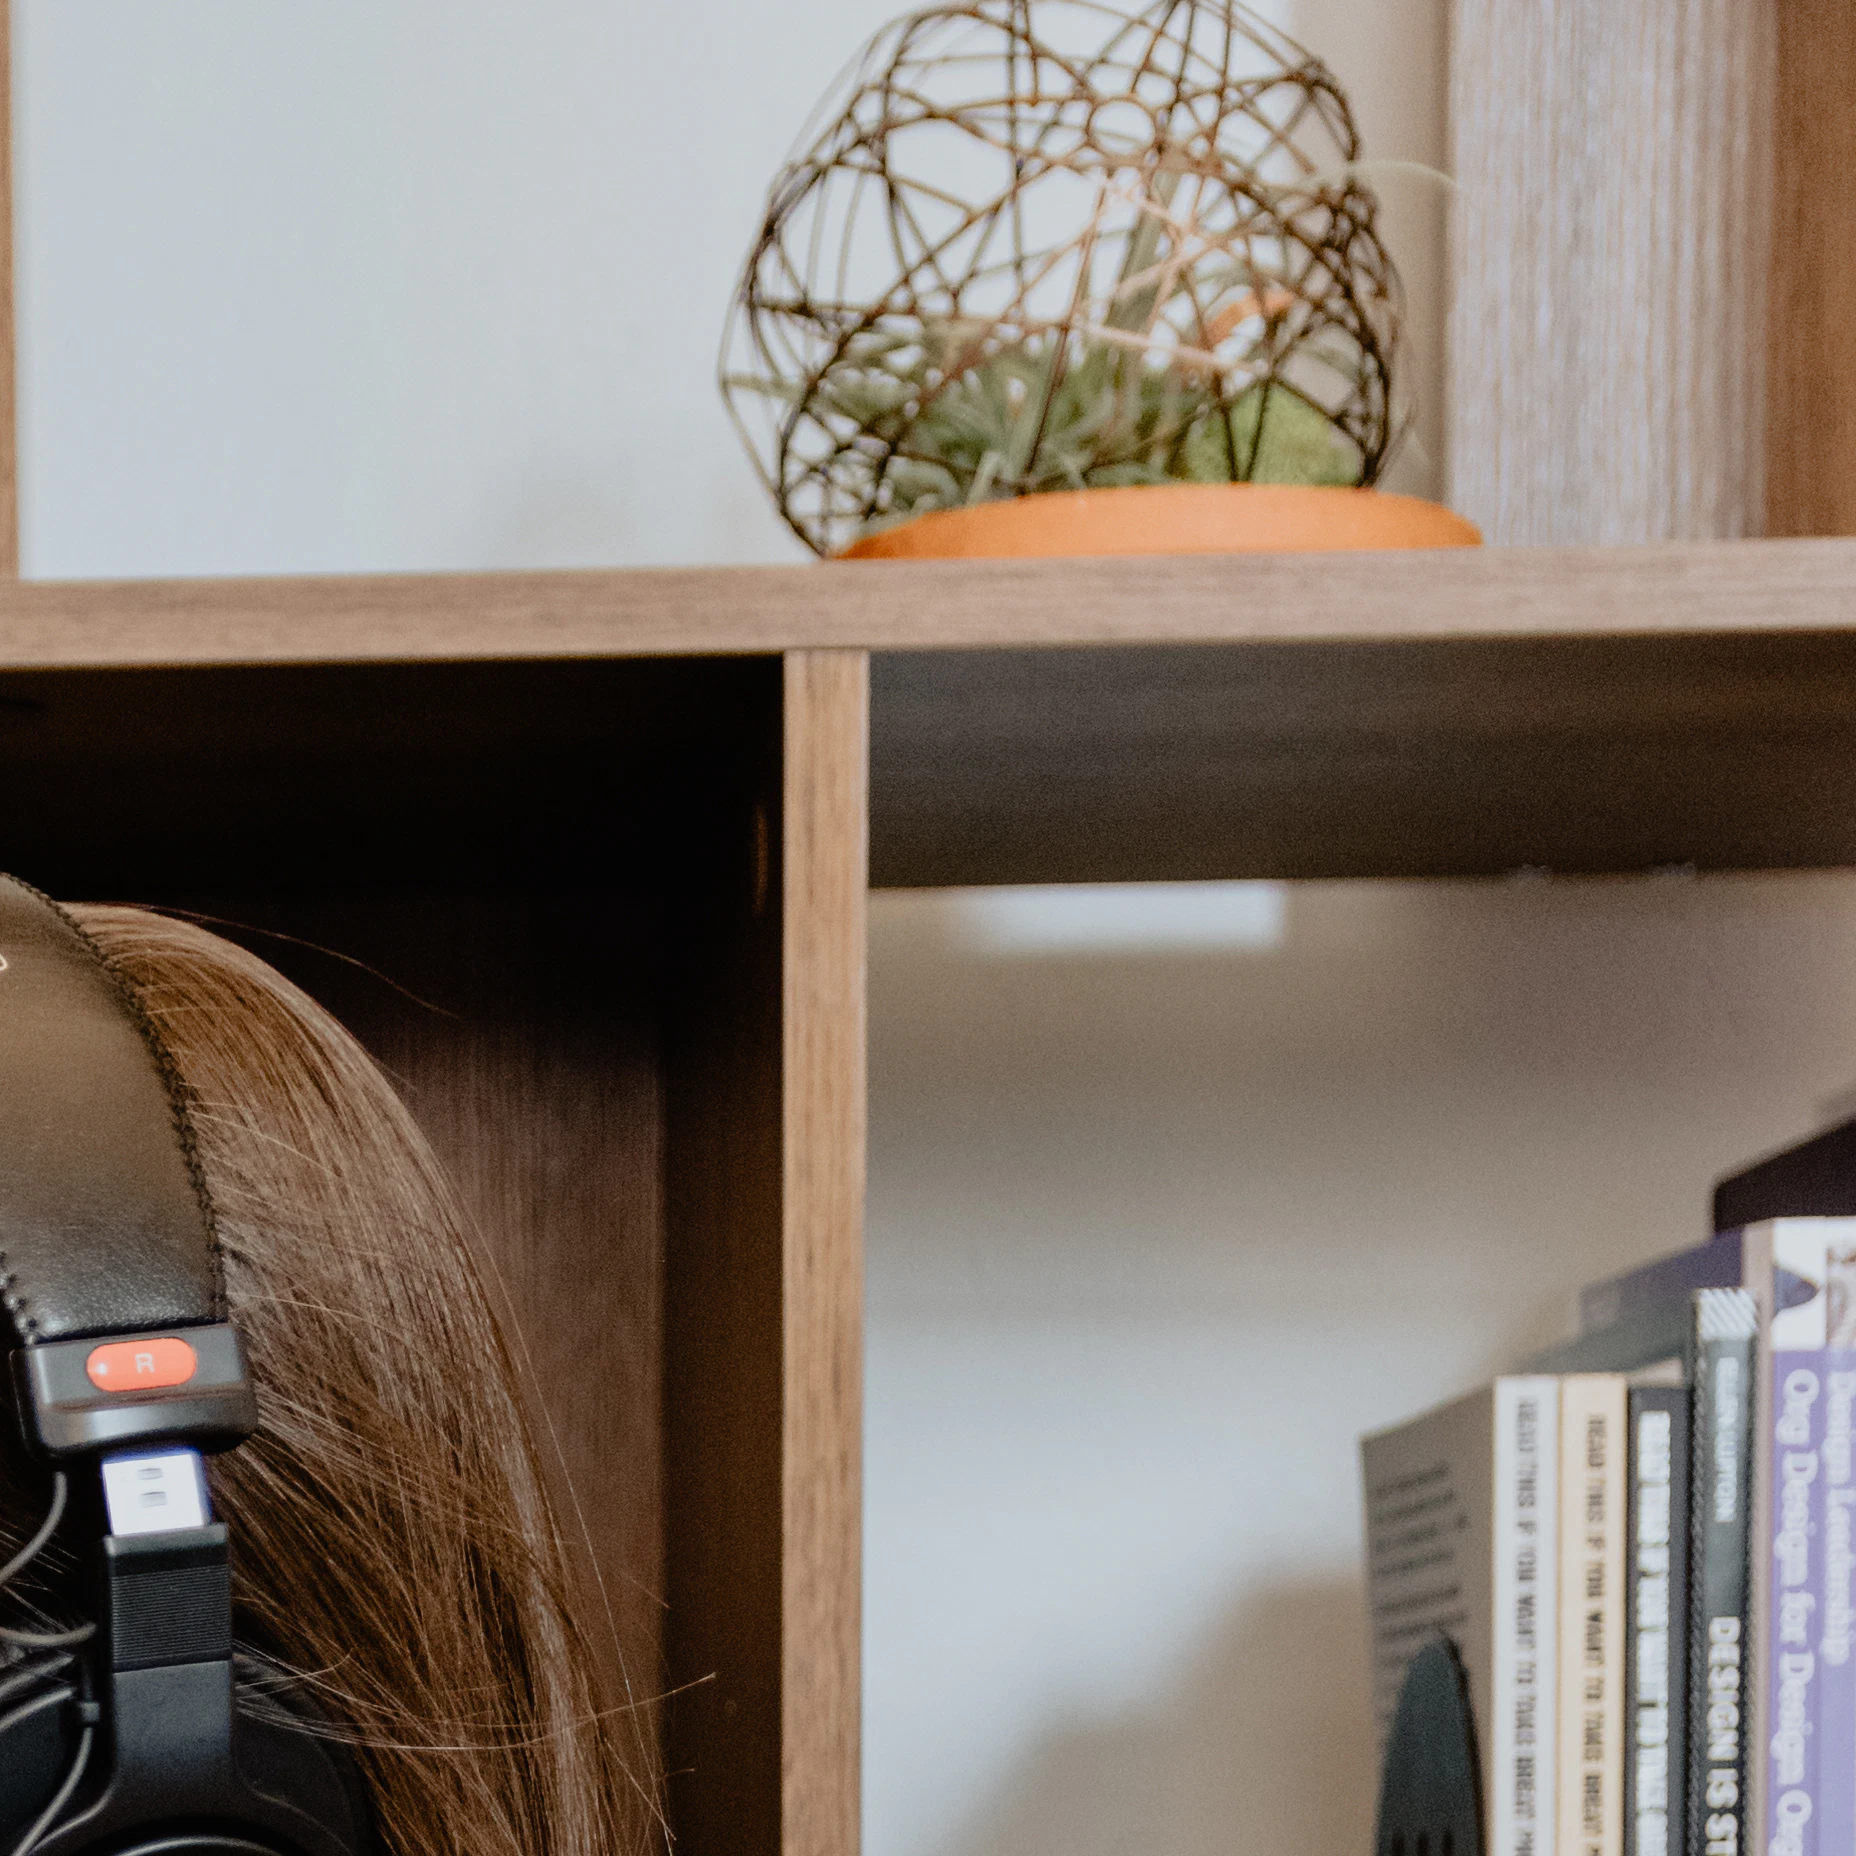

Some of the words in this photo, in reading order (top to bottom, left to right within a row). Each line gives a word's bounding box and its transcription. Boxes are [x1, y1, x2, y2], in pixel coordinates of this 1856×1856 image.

[134, 1352, 156, 1375] R
[1774, 1369, 1820, 1445] Org
[1774, 1450, 1818, 1586] Design
[1778, 1590, 1815, 1646] for
[1707, 1616, 1741, 1760] DESIGN
[1770, 1651, 1816, 1787] Design
[1706, 1768, 1738, 1808] IS
